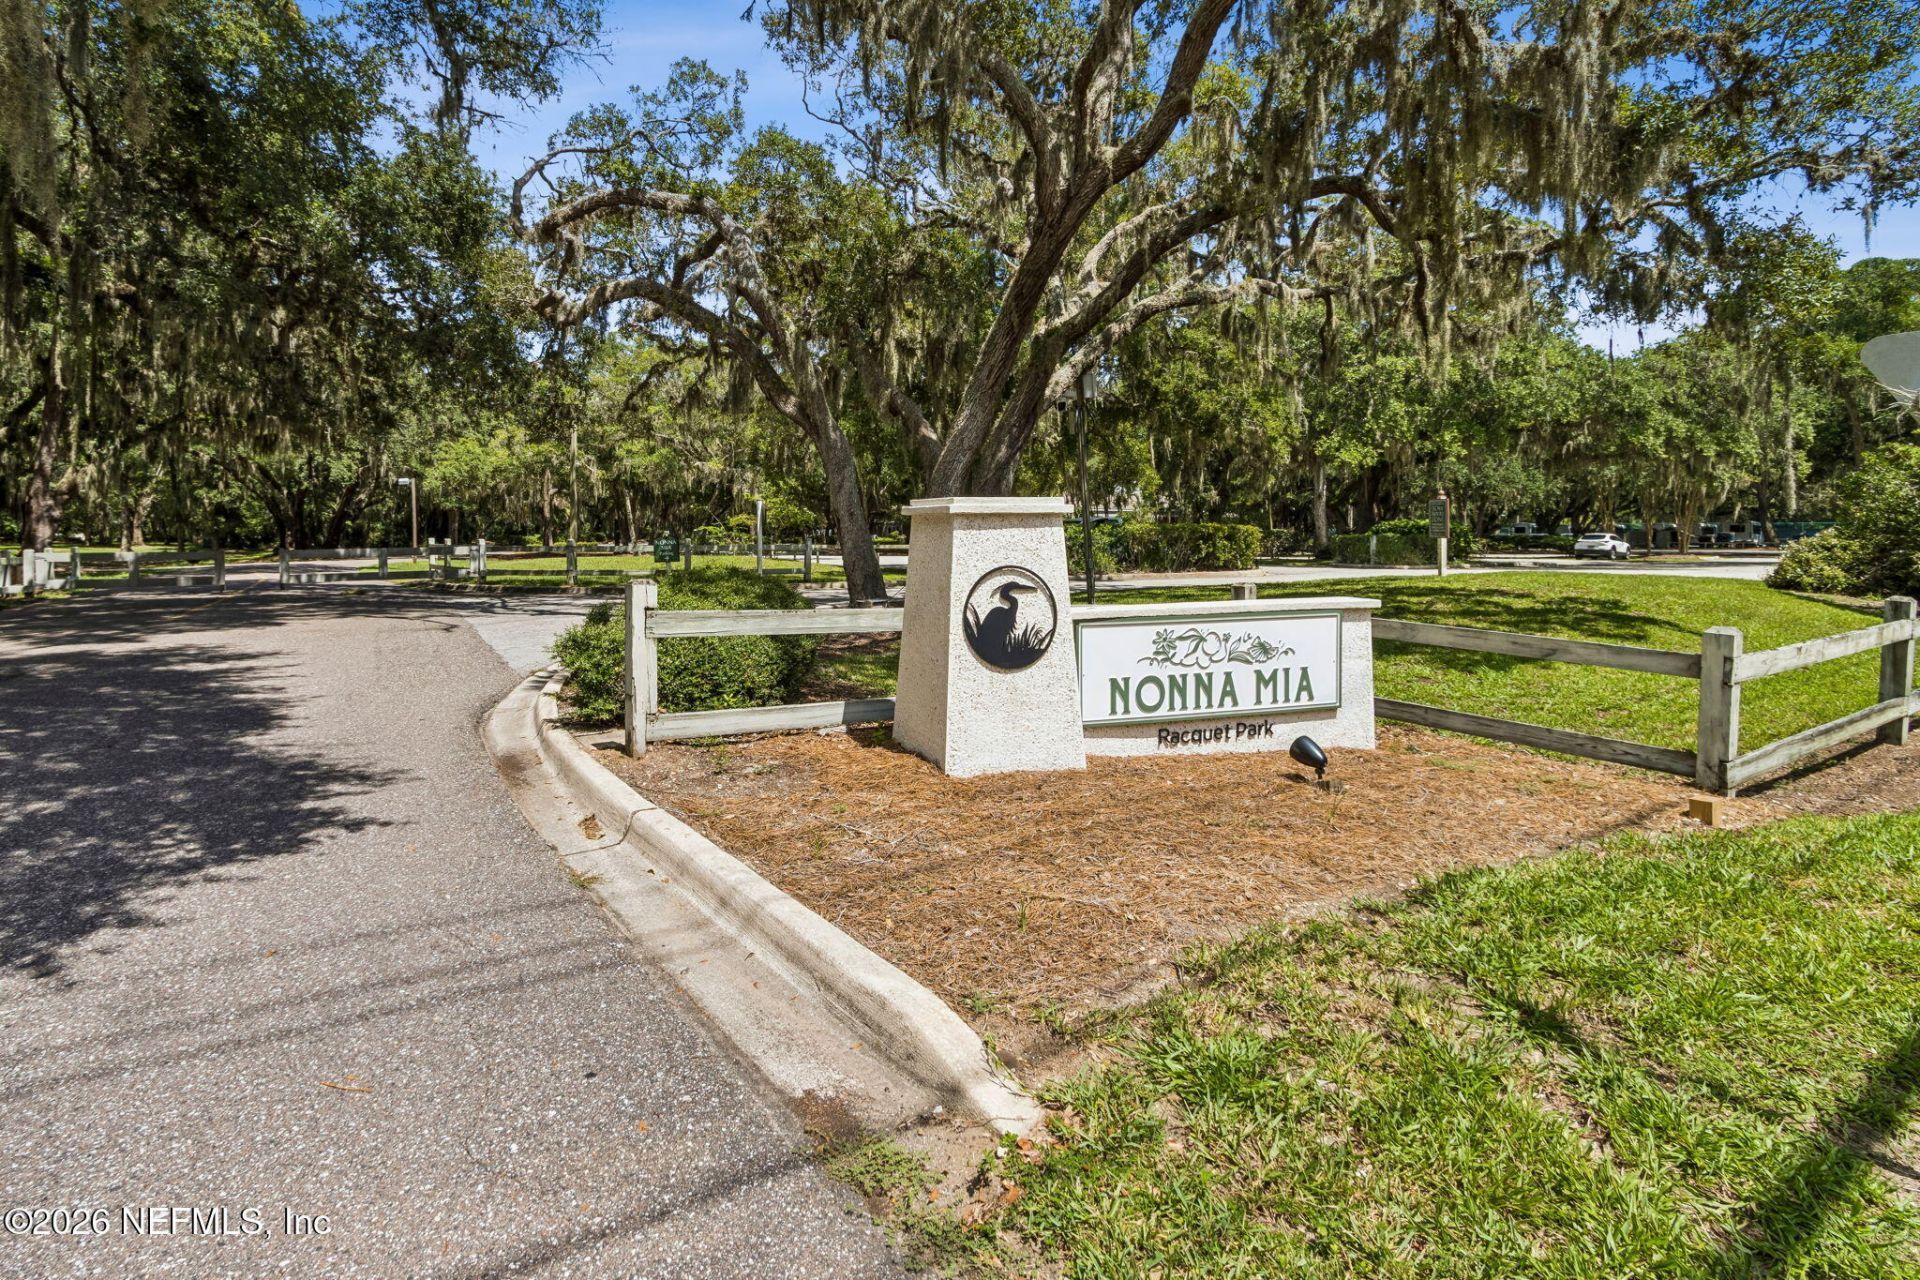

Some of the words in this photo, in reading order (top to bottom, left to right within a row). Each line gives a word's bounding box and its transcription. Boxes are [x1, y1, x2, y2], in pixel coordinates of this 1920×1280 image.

[1108, 671, 1239, 716] NONNA
[1253, 666, 1315, 706] MIA
[1158, 725, 1231, 745] Racquet
[1236, 720, 1274, 738] Park
